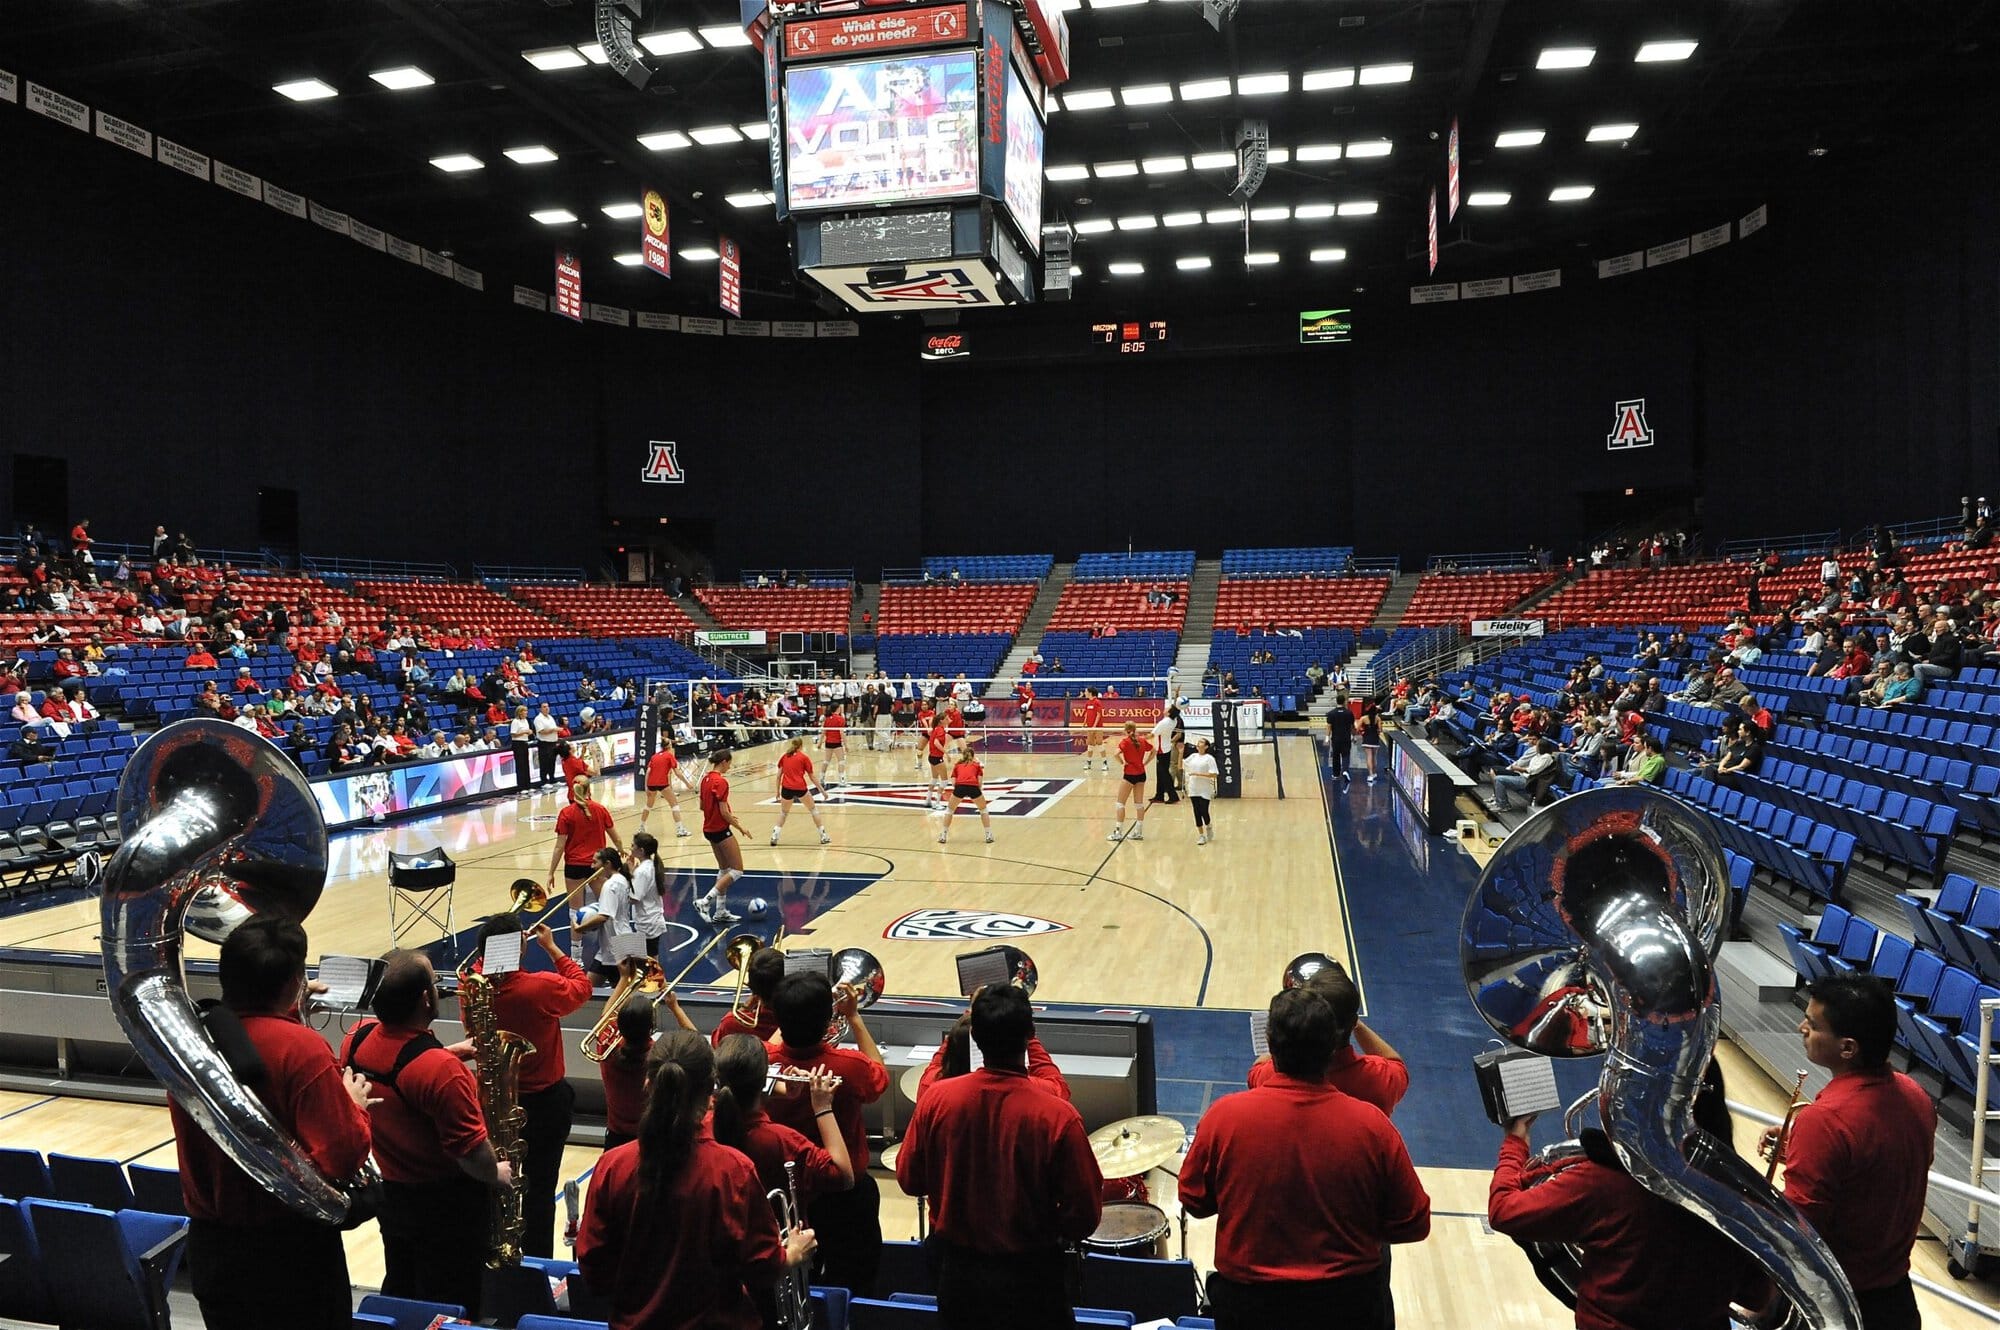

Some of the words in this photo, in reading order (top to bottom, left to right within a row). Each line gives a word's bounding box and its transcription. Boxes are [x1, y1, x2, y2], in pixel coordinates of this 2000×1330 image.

[842, 19, 875, 33] What
[879, 16, 905, 30] else
[831, 33, 848, 46] do
[851, 31, 874, 46] you
[877, 25, 917, 43] need?
[987, 33, 1004, 144] ARIZONA
[32, 85, 53, 100] CHASE
[54, 94, 85, 113] BUDINGER
[103, 115, 126, 130] GILBERT
[126, 125, 146, 139] ARENAS
[770, 104, 781, 183] DOWN
[645, 234, 668, 253] ARIZONA
[648, 249, 665, 269] 1988
[558, 263, 580, 278] ARIZONA
[1092, 324, 1117, 332] ARIZONA
[1106, 332, 1112, 342] 0
[1159, 329, 1166, 340] 0
[1121, 342, 1146, 353] 16:05
[1607, 398, 1655, 450] A
[642, 440, 685, 484] A
[1490, 622, 1530, 631] Fidelity
[1073, 707, 1117, 718] WLS
[1118, 707, 1161, 718] FARGO
[639, 711, 648, 775] ARIZONA
[1221, 711, 1232, 783] WILDCATS
